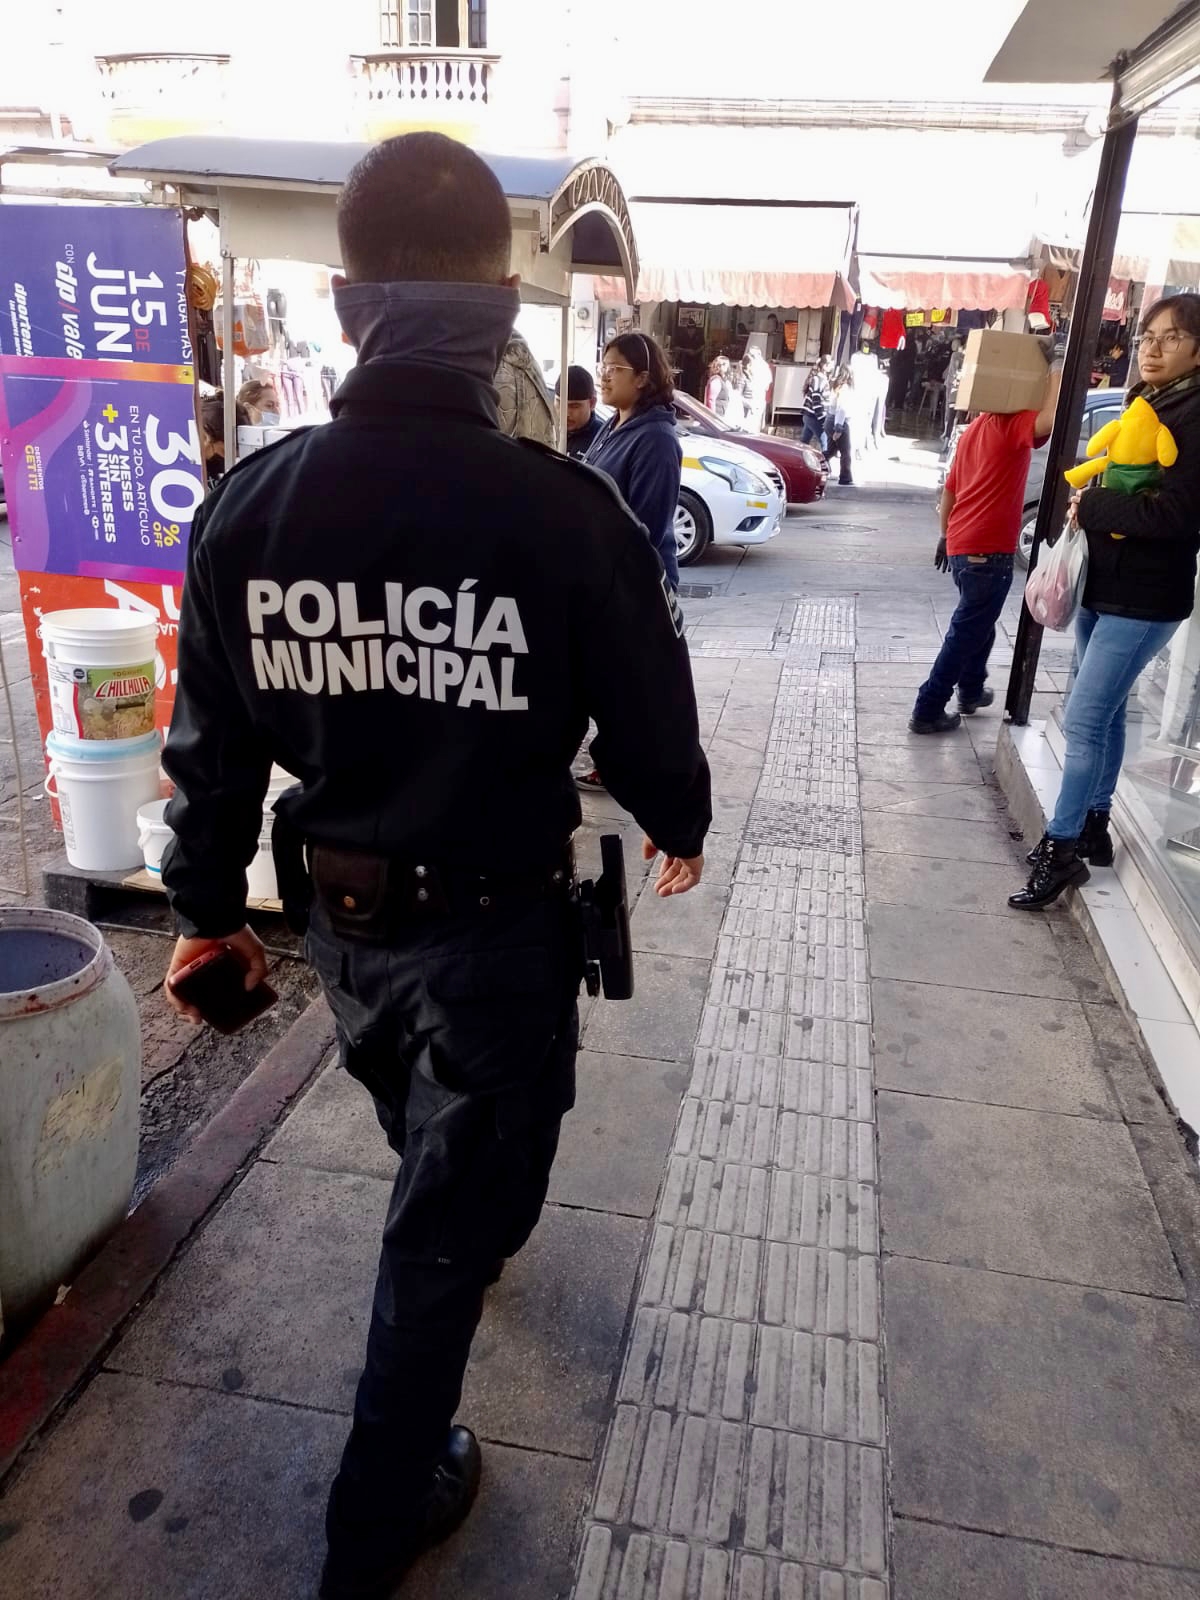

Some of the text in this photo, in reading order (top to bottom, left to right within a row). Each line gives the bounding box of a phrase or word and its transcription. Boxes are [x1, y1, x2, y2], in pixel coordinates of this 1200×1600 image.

[65, 243, 75, 264] CON
[175, 268, 187, 277] Y
[128, 270, 167, 352] 15 DE
[24, 444, 39, 491] GET IT!
[34, 446, 44, 490] DESCUENTOS
[84, 428, 92, 461] Santander
[108, 453, 121, 482] SIN
[97, 453, 117, 543] INTERESES
[118, 455, 134, 512] MESES
[129, 405, 150, 546] EN TU 2DO. ARTÍCULO
[152, 521, 163, 548] OFF
[247, 578, 529, 654] POLICÍA
[251, 638, 529, 711] MUNICIPAL
